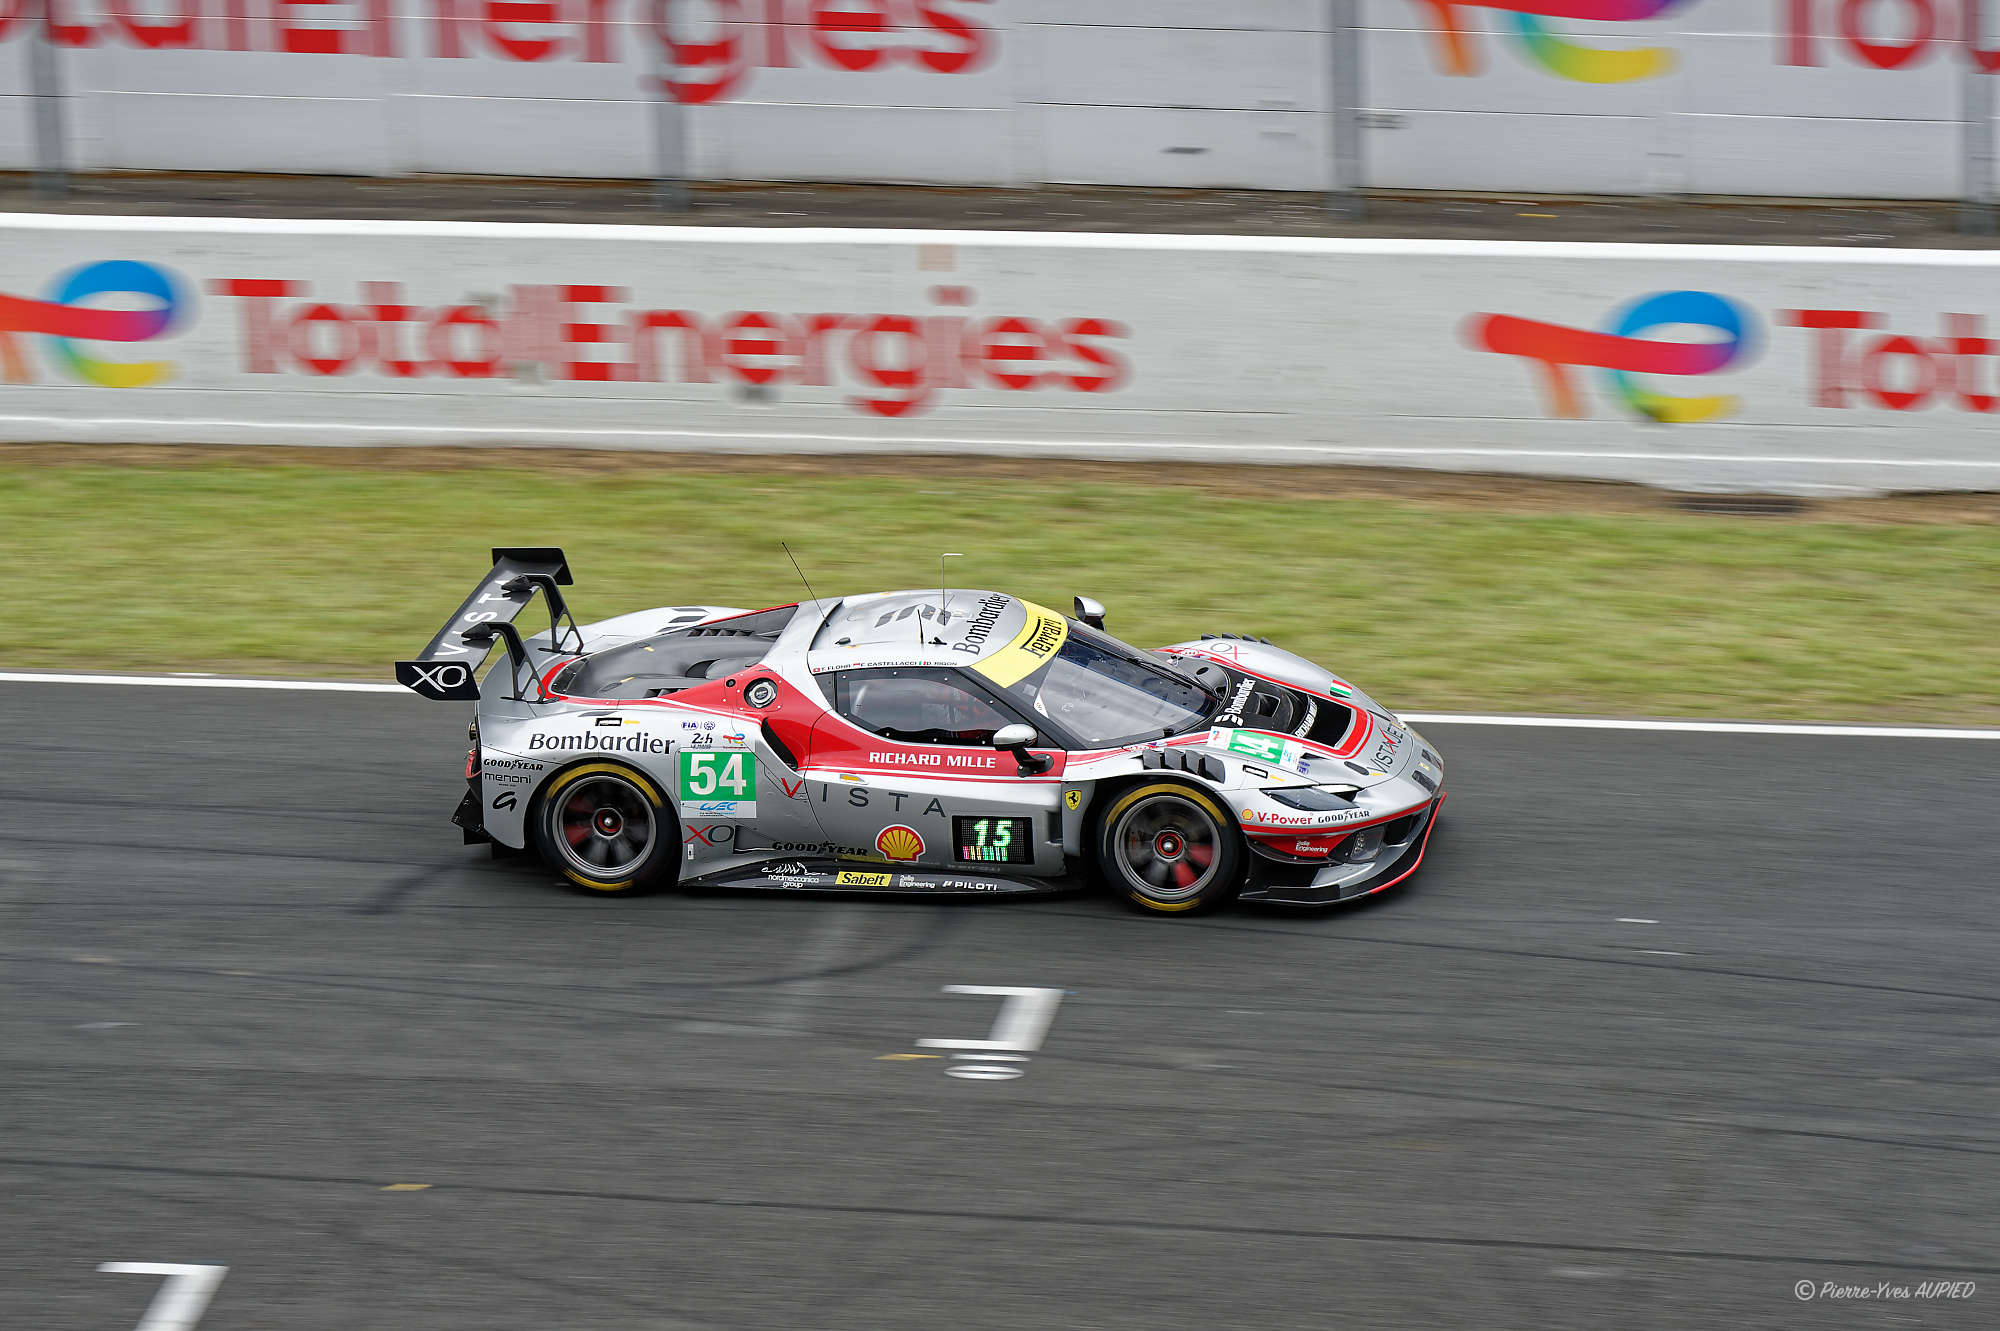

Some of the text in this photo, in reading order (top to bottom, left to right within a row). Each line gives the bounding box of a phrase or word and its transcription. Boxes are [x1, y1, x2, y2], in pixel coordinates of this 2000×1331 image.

[202, 278, 1134, 416] TotalEnergies
[952, 593, 1011, 656] Bombardier
[1020, 616, 1062, 659] Ferrari
[410, 665, 467, 693] XO
[529, 731, 675, 755] Bombardier
[869, 752, 997, 769] RICHARD MILLE
[484, 773, 532, 784] menoni
[689, 753, 747, 796] 54
[699, 801, 737, 811] WEC
[781, 777, 947, 818] VISTA
[1257, 812, 1313, 825] V-Power
[684, 825, 735, 847] XO
[973, 819, 1013, 847] 15
[842, 872, 885, 886] Sabelt
[899, 880, 936, 889] Engineering
[954, 881, 997, 891] PILOTI
